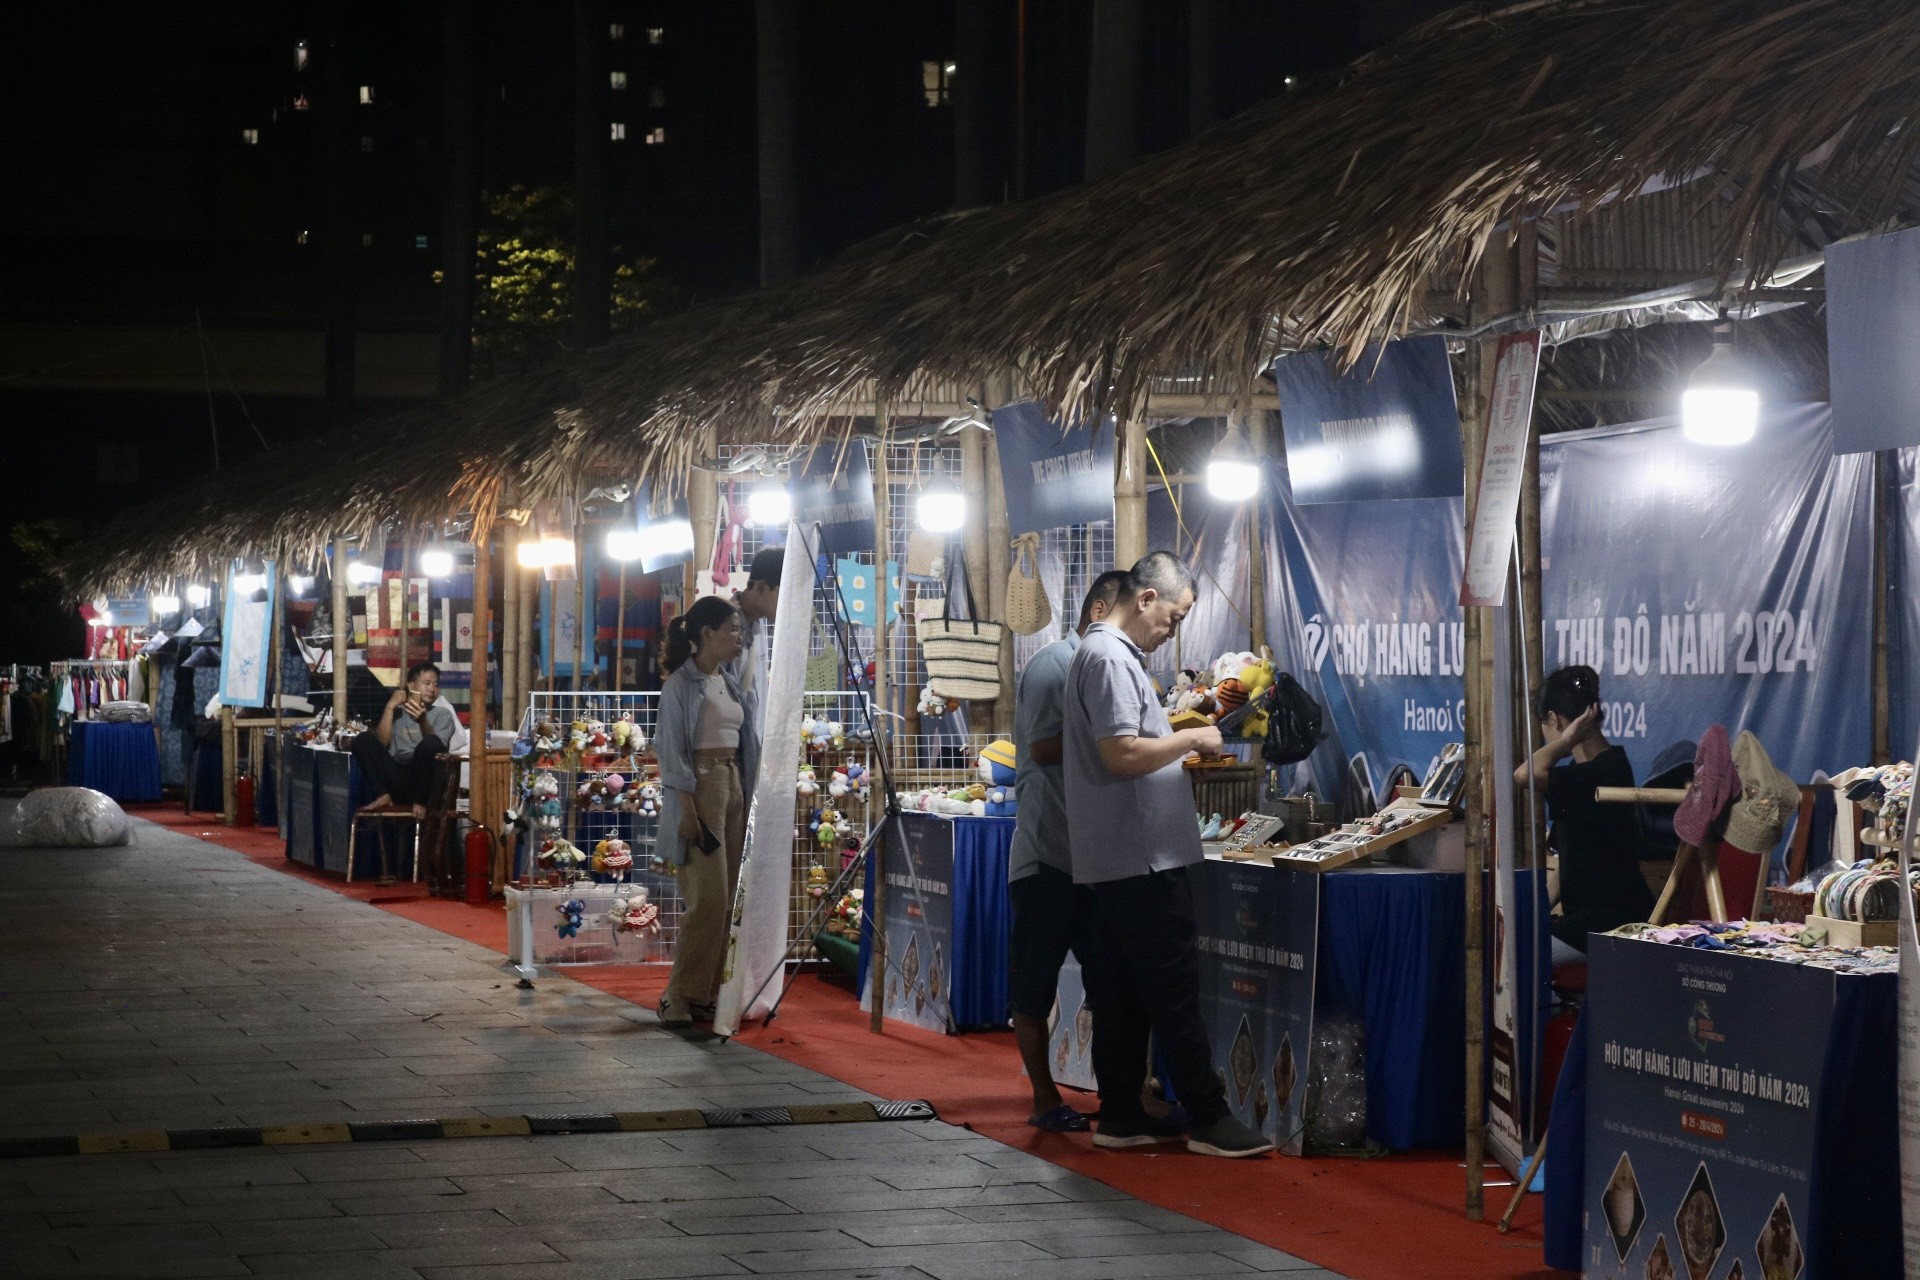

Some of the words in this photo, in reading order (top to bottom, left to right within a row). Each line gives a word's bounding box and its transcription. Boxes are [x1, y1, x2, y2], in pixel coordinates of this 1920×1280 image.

[1332, 618, 1370, 688] CHỢ
[1375, 613, 1432, 676] HÀNG
[1555, 597, 1604, 675] THỦ
[1613, 603, 1651, 676] ĐÔ
[1660, 600, 1725, 675] NĂM
[1735, 608, 1818, 674] 2024
[1404, 698, 1453, 732] Hanoi
[1602, 701, 1648, 738] 2024
[1290, 952, 1304, 971] 2024
[1604, 1040, 1621, 1070] HỘI
[1623, 1047, 1642, 1075] CHỢ
[1645, 1048, 1670, 1077] HÀNG
[1673, 1057, 1691, 1082] LƯU
[1693, 1060, 1718, 1090] NIỆM
[1721, 1063, 1740, 1092] THỦ
[1742, 1069, 1756, 1096] ĐÔ
[1759, 1073, 1782, 1102] NĂM
[1785, 1081, 1810, 1109] 2024
[1729, 1099, 1745, 1115] 2024
